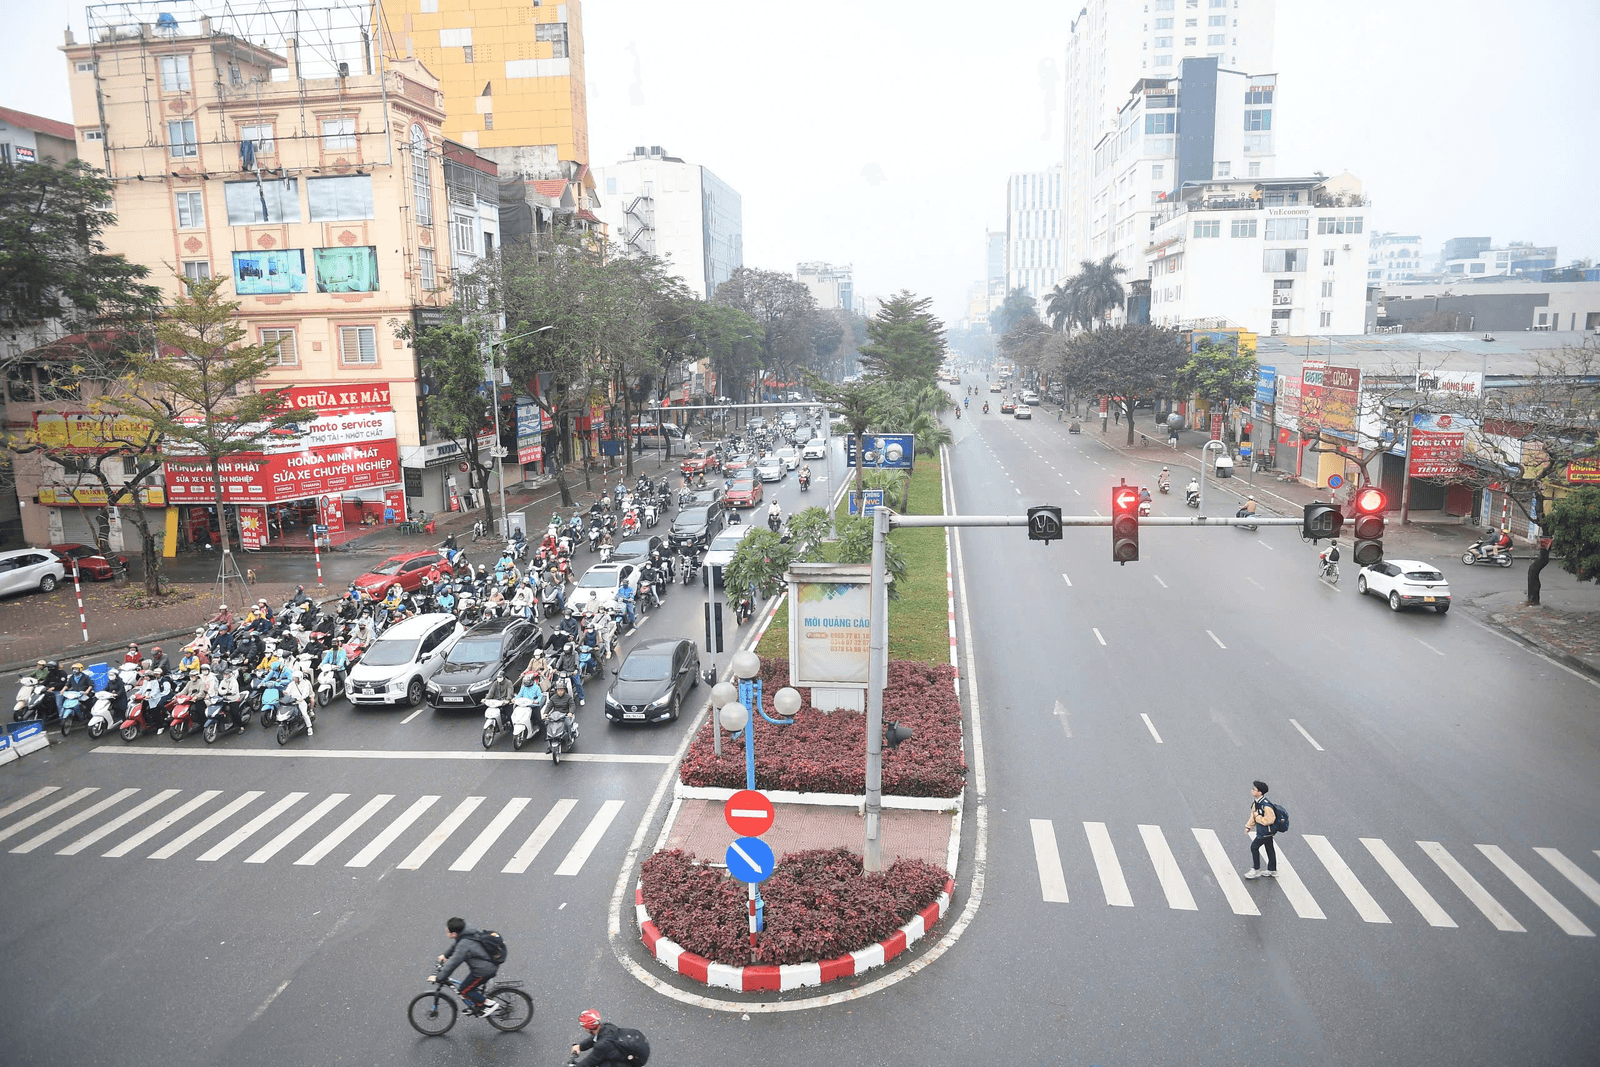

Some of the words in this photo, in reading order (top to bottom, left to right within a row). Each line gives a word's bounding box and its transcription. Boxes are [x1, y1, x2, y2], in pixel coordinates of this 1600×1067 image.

[1269, 208, 1311, 218] VnEconomy
[297, 390, 337, 407] CHỮA
[340, 392, 358, 405] XE
[361, 387, 389, 403] MÁY
[309, 422, 338, 433] moto
[341, 418, 383, 431] services
[310, 434, 327, 443] THỢ
[327, 432, 339, 442] TÀI
[345, 430, 364, 439] NHỚT
[365, 429, 383, 438] CHẤT
[287, 454, 325, 467] HONDA
[326, 450, 352, 462] MINH
[354, 446, 379, 460] PHÁT
[167, 463, 203, 472] HONDA
[205, 462, 232, 472] MNH
[234, 462, 260, 472] PHÁT
[273, 469, 296, 483] SỬA
[298, 469, 311, 480] XE
[313, 462, 355, 477] CHUYÊN
[356, 457, 392, 472] NGHIỆP
[175, 474, 190, 483] SỬA
[229, 475, 253, 484] NGHIỆP
[804, 615, 820, 627] MỜI
[822, 616, 851, 628] QUẢNG
[853, 616, 870, 628] CÁO
